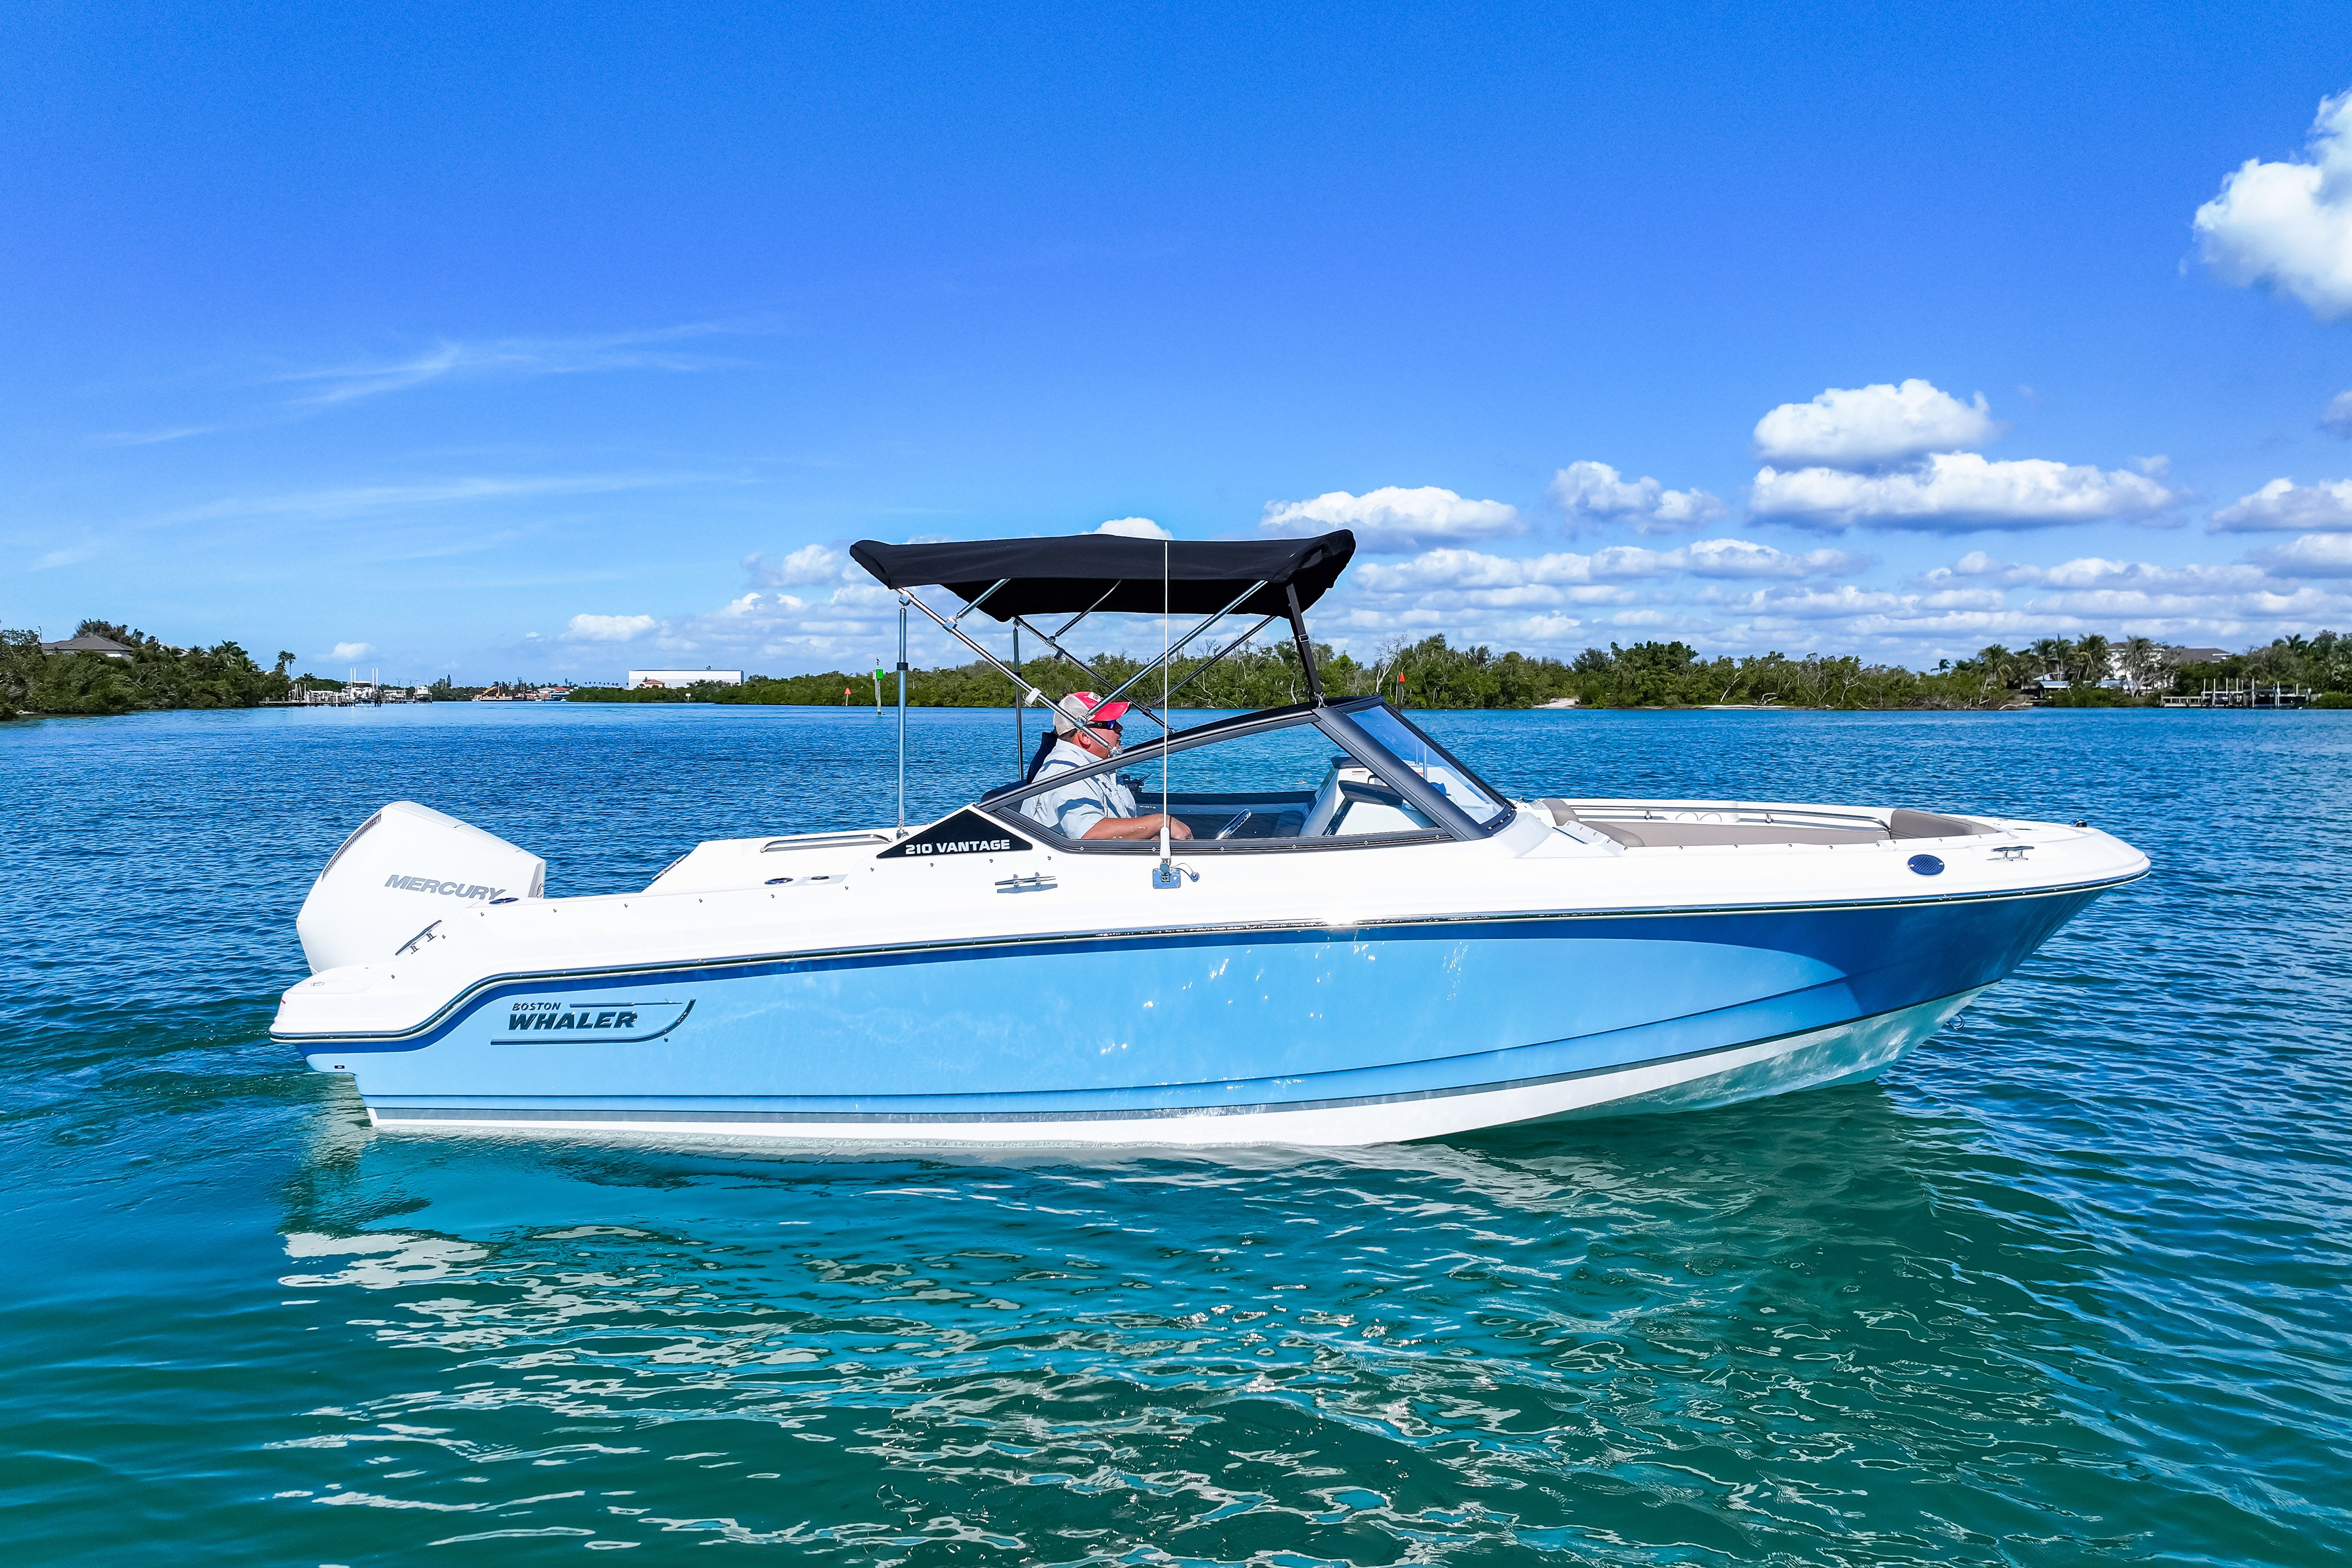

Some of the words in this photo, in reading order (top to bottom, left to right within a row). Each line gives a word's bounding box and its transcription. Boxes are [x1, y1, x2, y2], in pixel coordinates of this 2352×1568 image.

[906, 843, 932, 854] 210
[936, 839, 1010, 853] VANTAGE
[384, 874, 506, 900] MERCURY
[512, 1002, 561, 1011] BOSTON
[508, 1011, 638, 1031] WHALER
